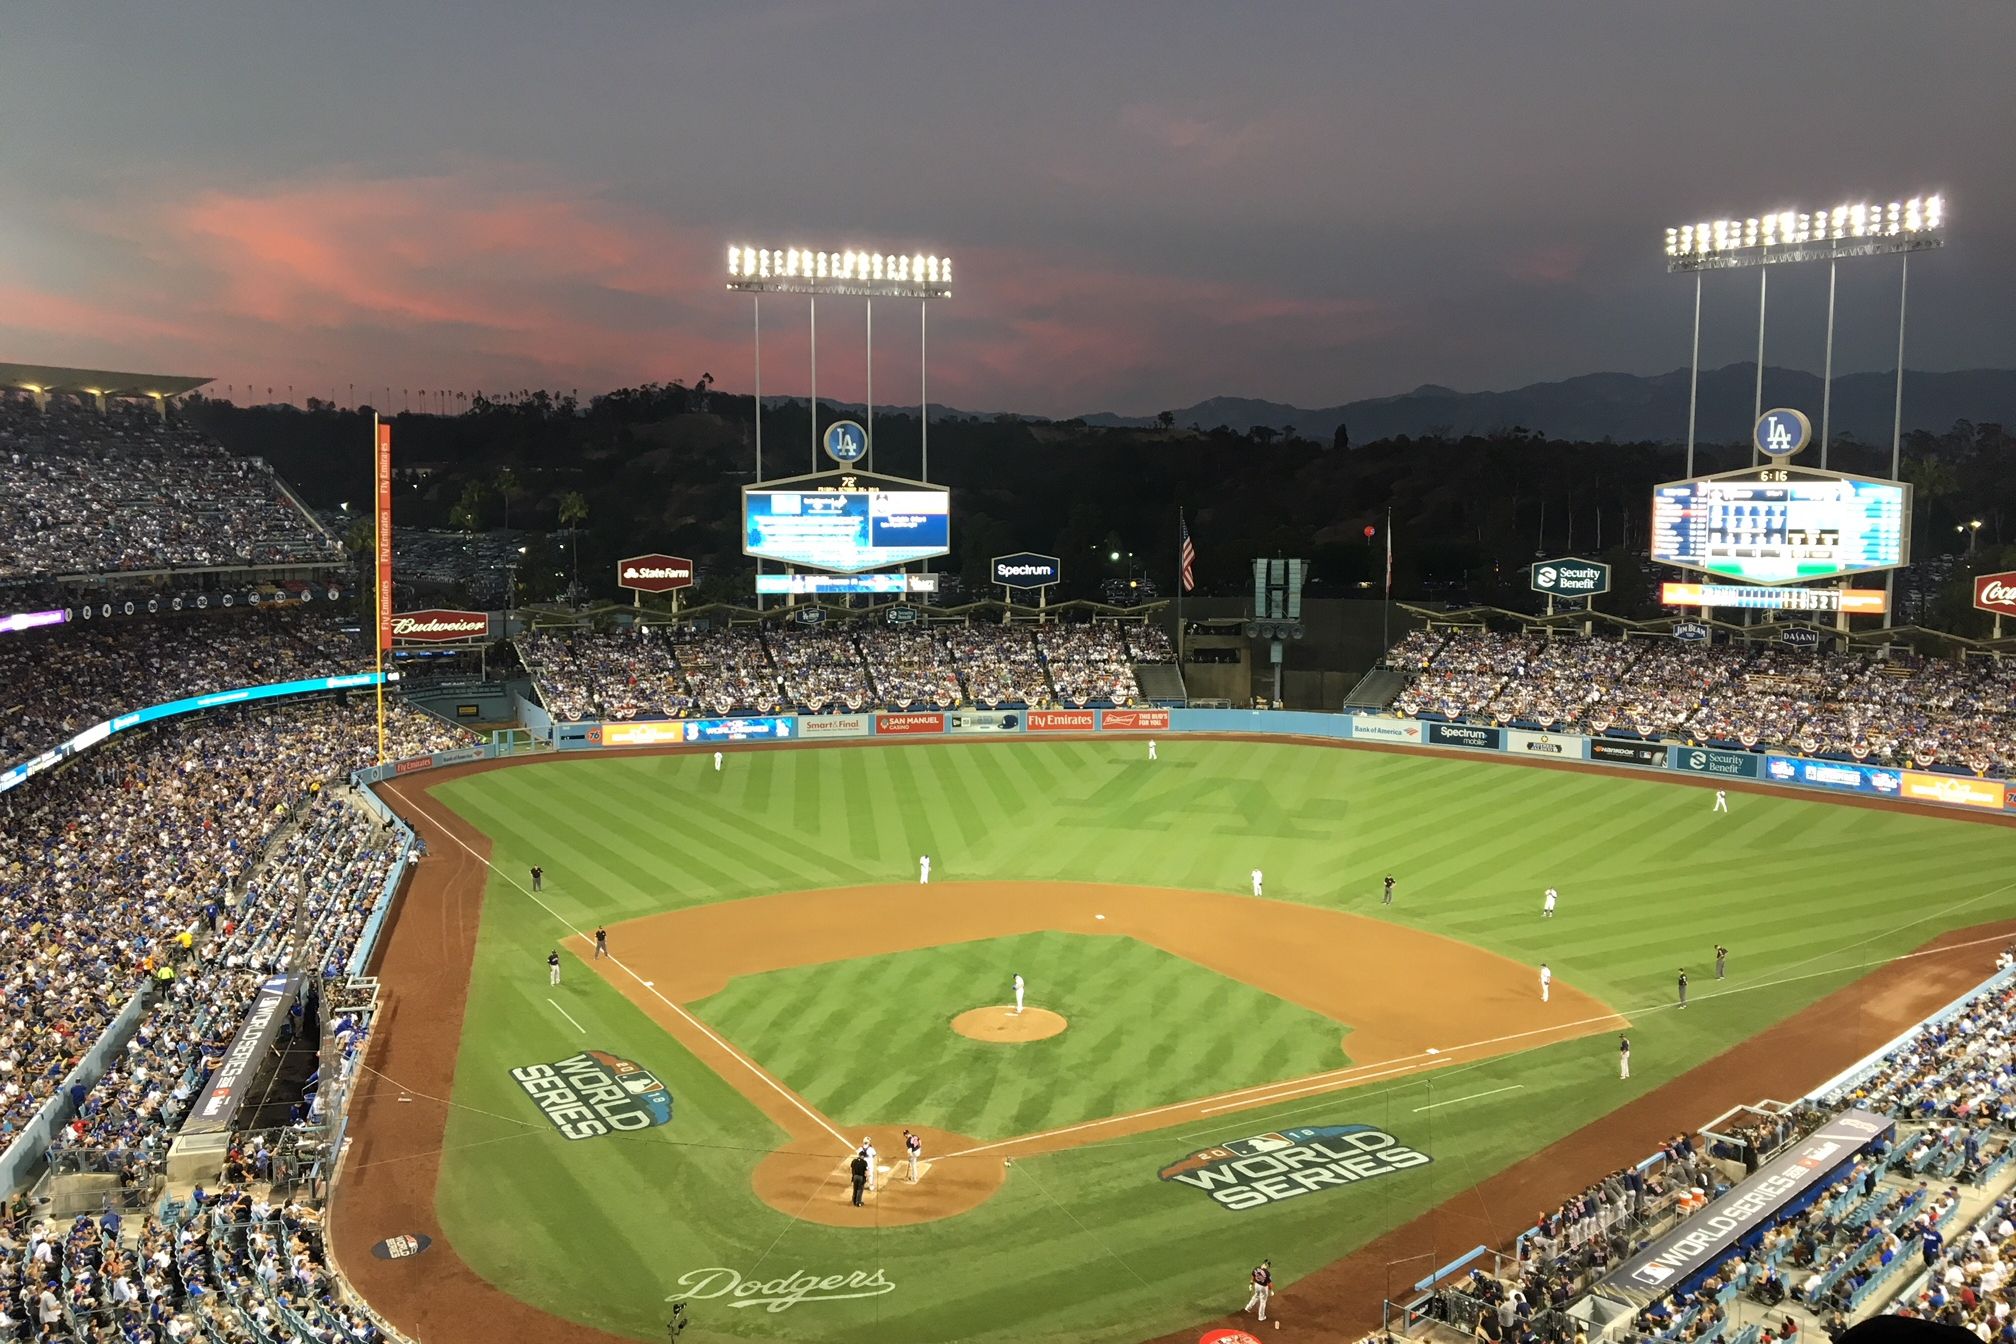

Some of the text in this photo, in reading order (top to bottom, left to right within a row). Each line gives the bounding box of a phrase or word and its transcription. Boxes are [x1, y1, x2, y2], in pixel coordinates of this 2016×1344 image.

[1767, 416, 1791, 449] LA
[837, 428, 856, 456] LA
[1761, 471, 1789, 481] 6:16
[381, 480, 389, 494] Fly
[381, 549, 389, 562] Fly
[997, 564, 1051, 578] Spectrum
[1560, 567, 1600, 580] Security
[1560, 578, 1595, 589] Benefit
[391, 618, 485, 634] Budweiser
[1783, 632, 1816, 642] DASANI
[889, 716, 939, 725] SAN MANUEL
[1028, 714, 1092, 727] Fly Emirates
[1354, 725, 1370, 733] Bank
[1376, 727, 1402, 736] America
[1440, 726, 1485, 738] Spectrum
[1463, 738, 1485, 746] mobile
[1709, 752, 1743, 765] Security
[1709, 762, 1739, 774] Benefit
[616, 1061, 666, 1104] 20 18
[554, 1053, 650, 1131] WORLD
[511, 1063, 608, 1140] SERIES
[1198, 1129, 1315, 1160] 20 18
[1174, 1131, 1397, 1190] WORLD
[1213, 1146, 1430, 1210] SERIES
[1655, 1216, 1738, 1268] WORLD
[1723, 1174, 1796, 1221] SERIES
[664, 1267, 895, 1313] Dodgers
